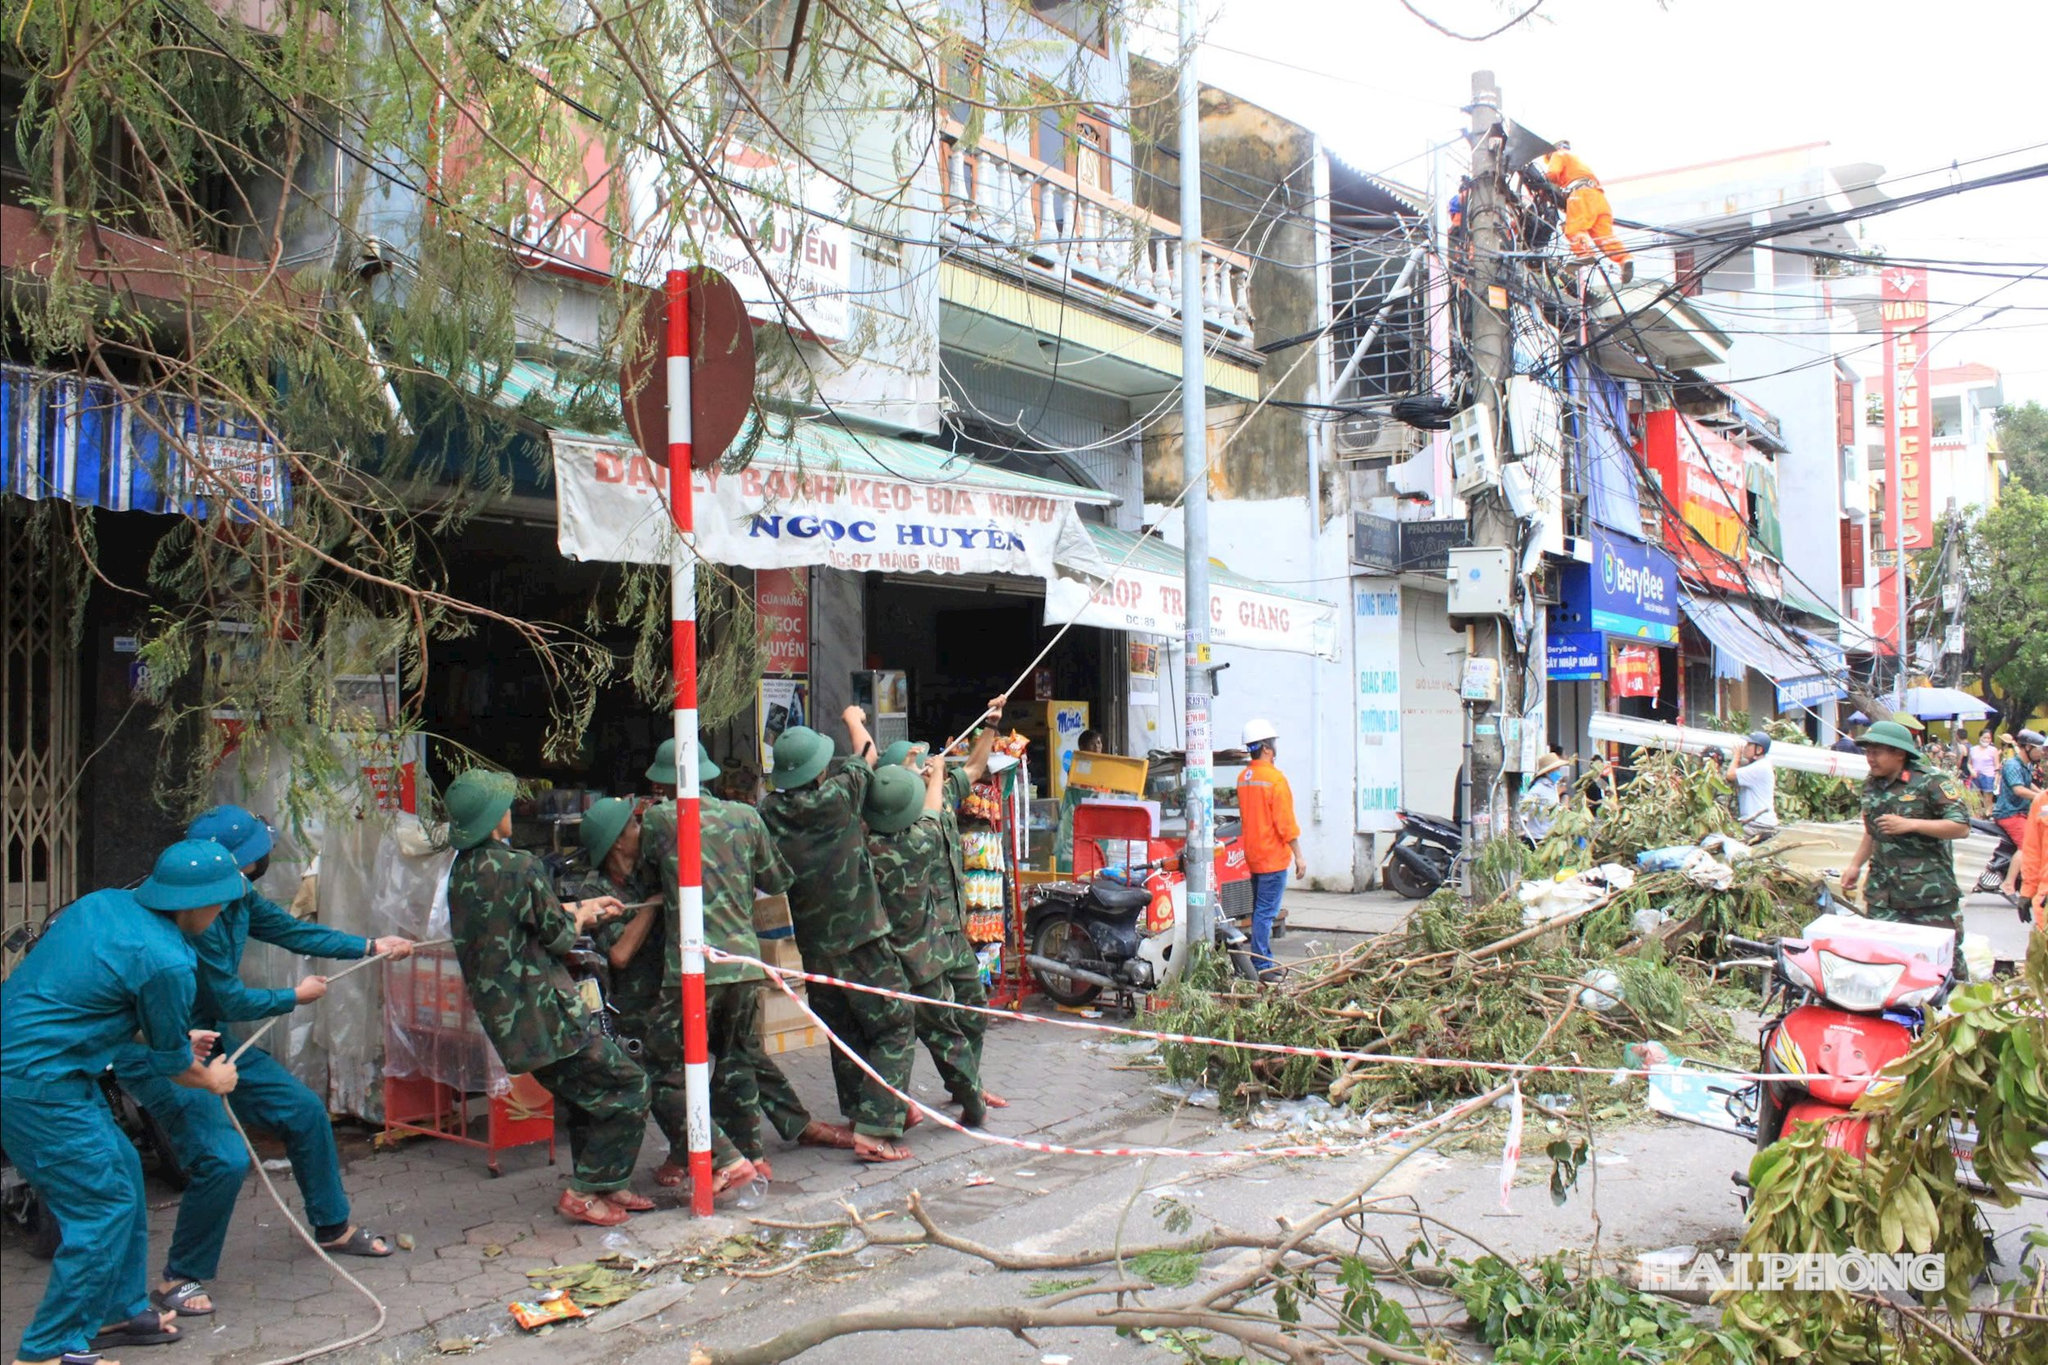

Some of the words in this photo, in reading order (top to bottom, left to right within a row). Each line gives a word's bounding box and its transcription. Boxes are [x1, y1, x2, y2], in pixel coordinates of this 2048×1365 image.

[748, 513, 877, 549] NGỌC
[1617, 558, 1665, 605] BeryBee
[1238, 600, 1291, 633] GIANG
[1829, 1024, 1865, 1036] HONDA
